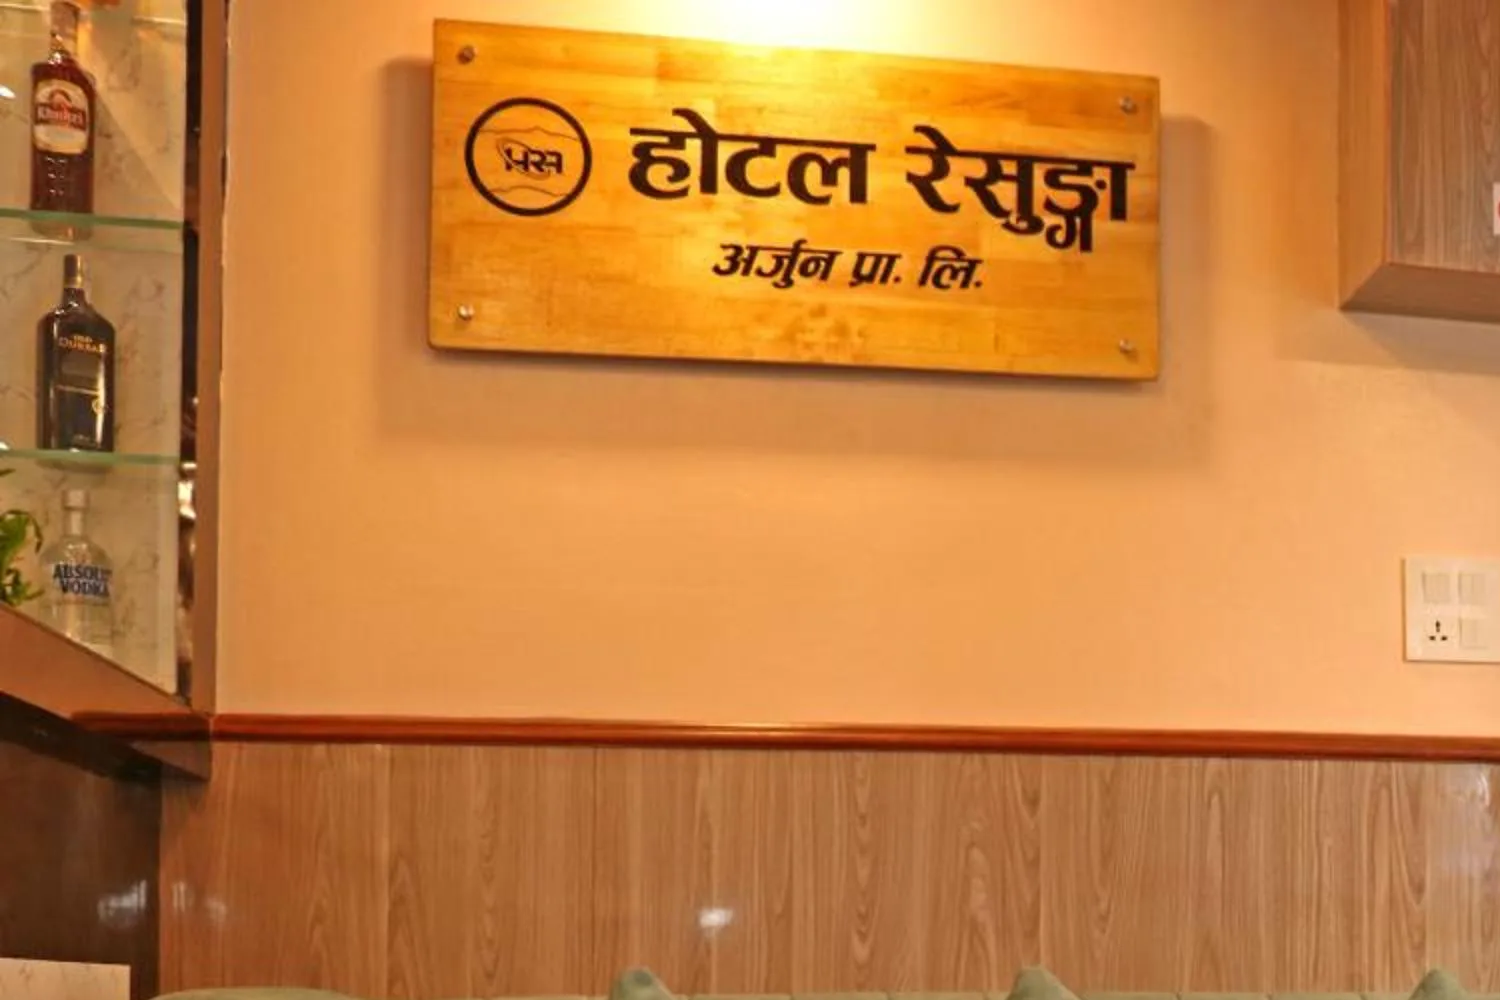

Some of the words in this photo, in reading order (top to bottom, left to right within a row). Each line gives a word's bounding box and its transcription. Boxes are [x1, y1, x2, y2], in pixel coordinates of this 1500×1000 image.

[628, 107, 877, 206] होटल
[712, 240, 840, 289] अर्जुन
[850, 251, 902, 288] प्रा.
[918, 245, 984, 290] लि.
